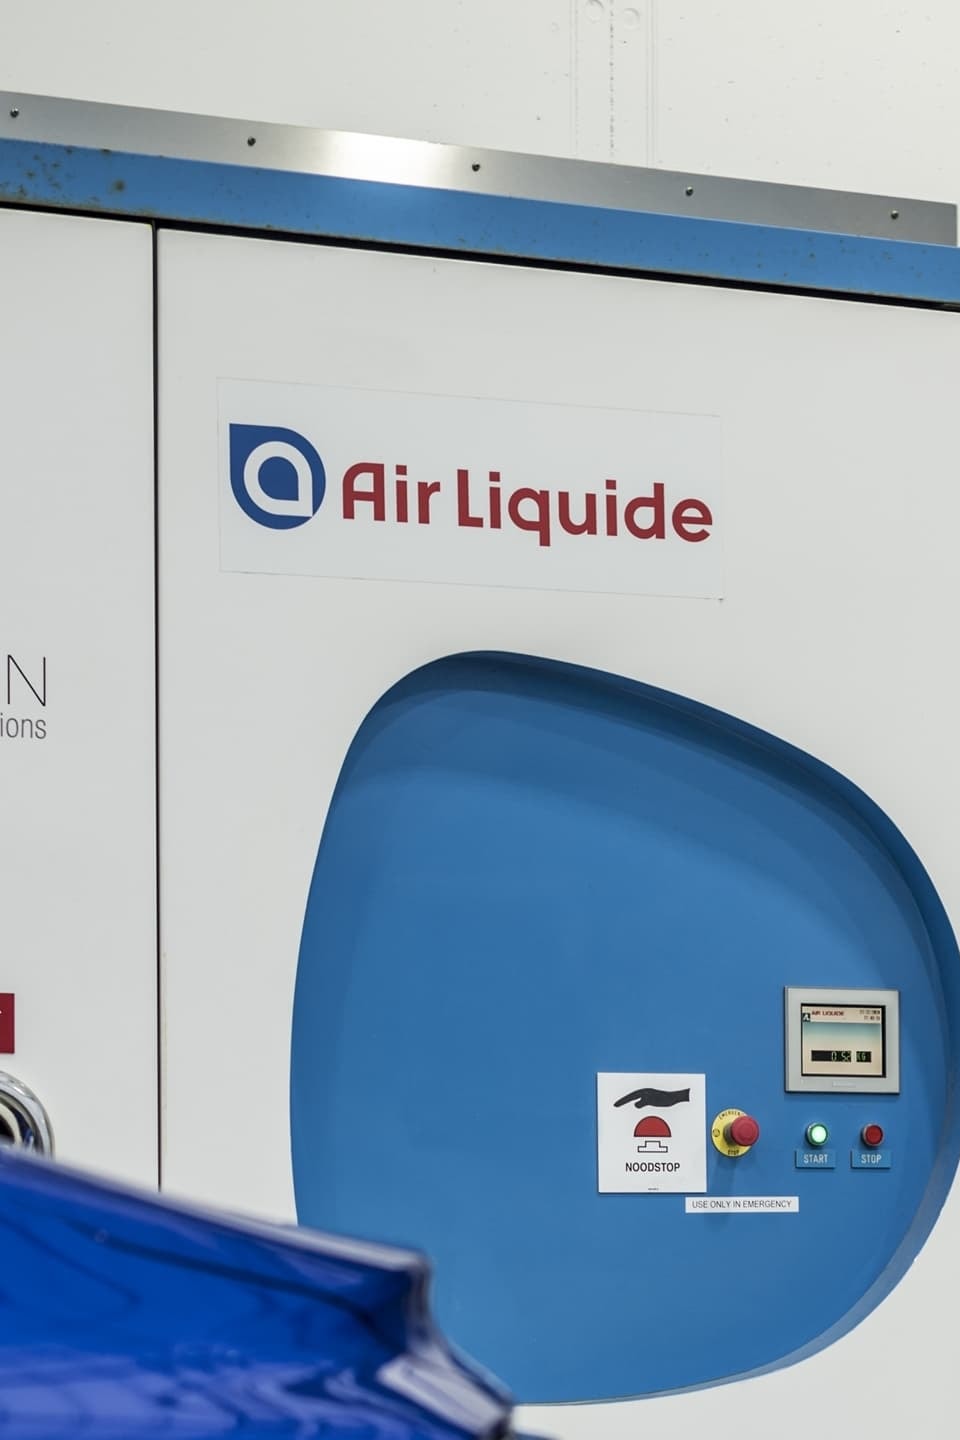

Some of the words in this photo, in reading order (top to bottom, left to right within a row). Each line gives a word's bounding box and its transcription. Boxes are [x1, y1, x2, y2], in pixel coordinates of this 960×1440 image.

[342, 462, 440, 524] Air
[457, 468, 712, 547] Liquide
[803, 1153, 828, 1164] START
[861, 1153, 882, 1164] STOP
[625, 1162, 681, 1172] NOODSTOP
[692, 1200, 708, 1208] USE
[710, 1200, 731, 1208] ONLY
[733, 1200, 741, 1208] IN
[742, 1200, 792, 1208] EMERGENCY
